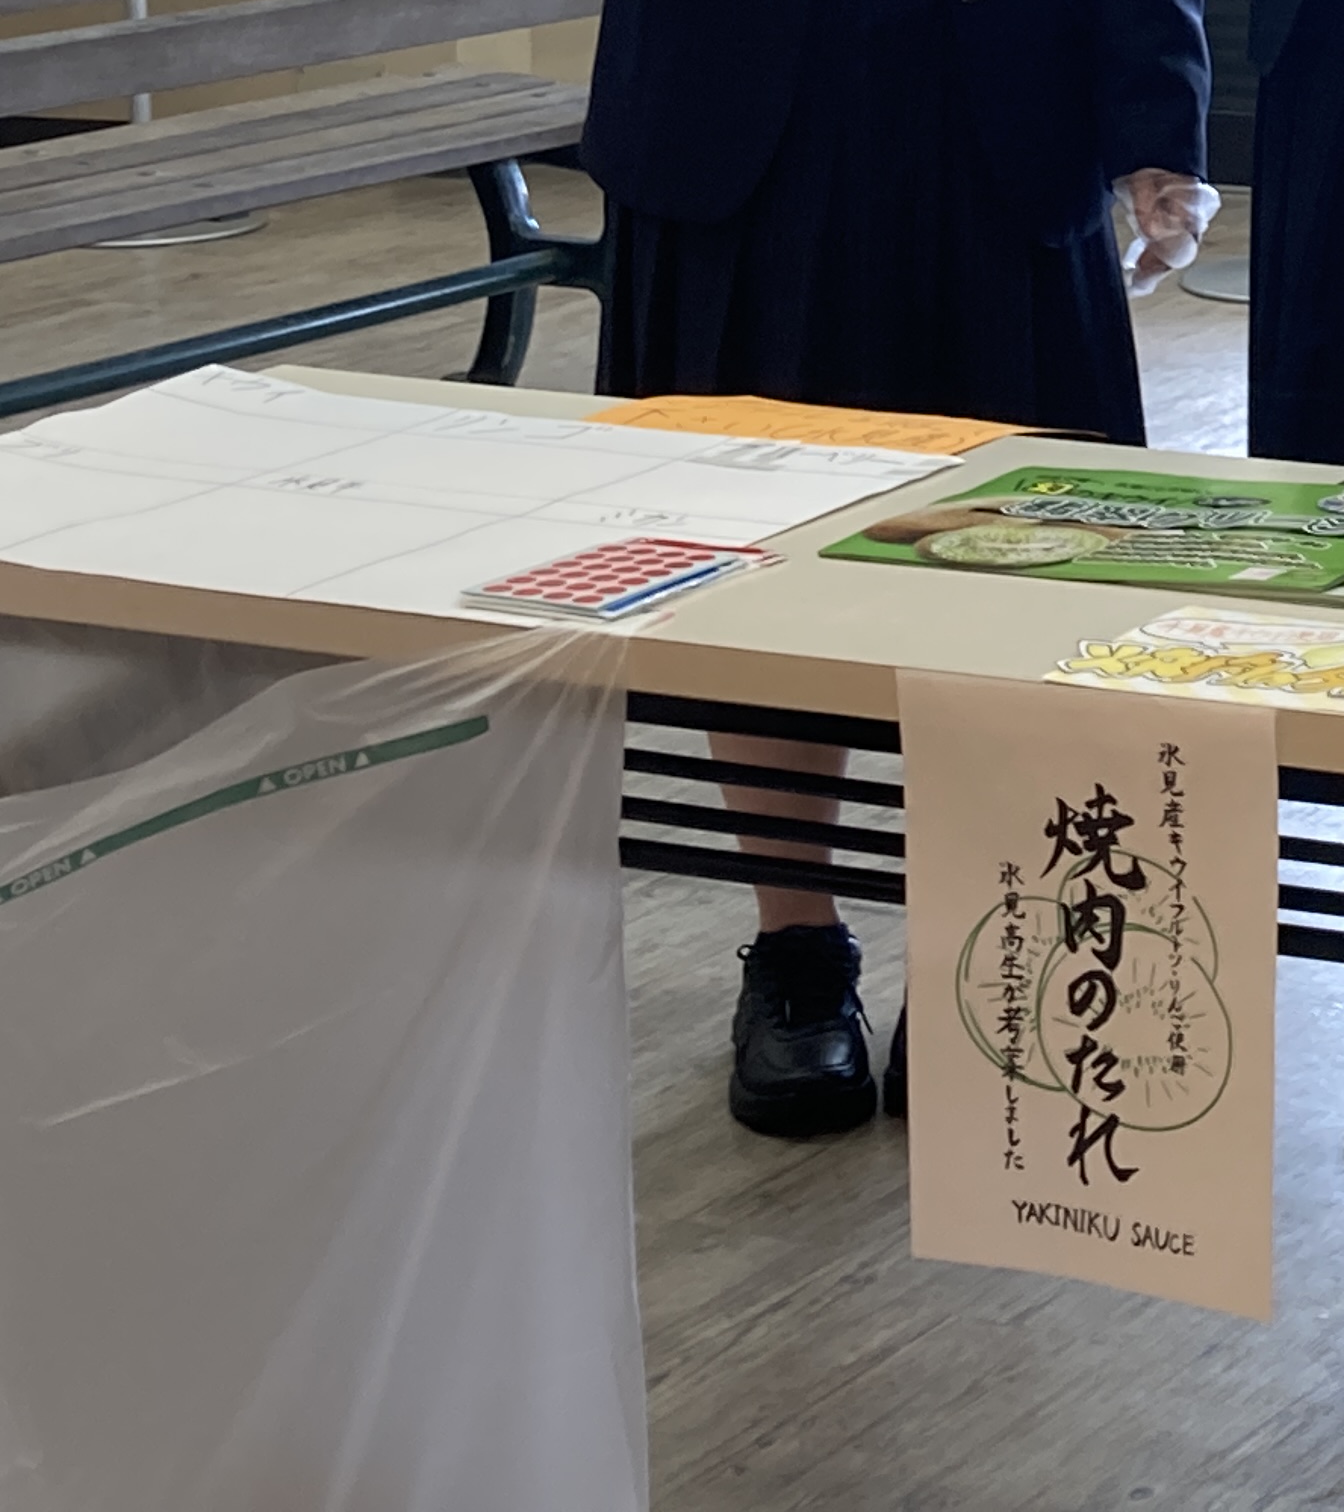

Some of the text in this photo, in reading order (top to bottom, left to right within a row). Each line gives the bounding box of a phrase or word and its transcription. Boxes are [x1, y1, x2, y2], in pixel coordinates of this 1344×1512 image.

[284, 752, 347, 786] OPEN
[12, 859, 71, 896] OPEN
[1041, 782, 1146, 1186] 焼肉のたれ
[1012, 1199, 1195, 1257] YAKINIKU SAUCE
